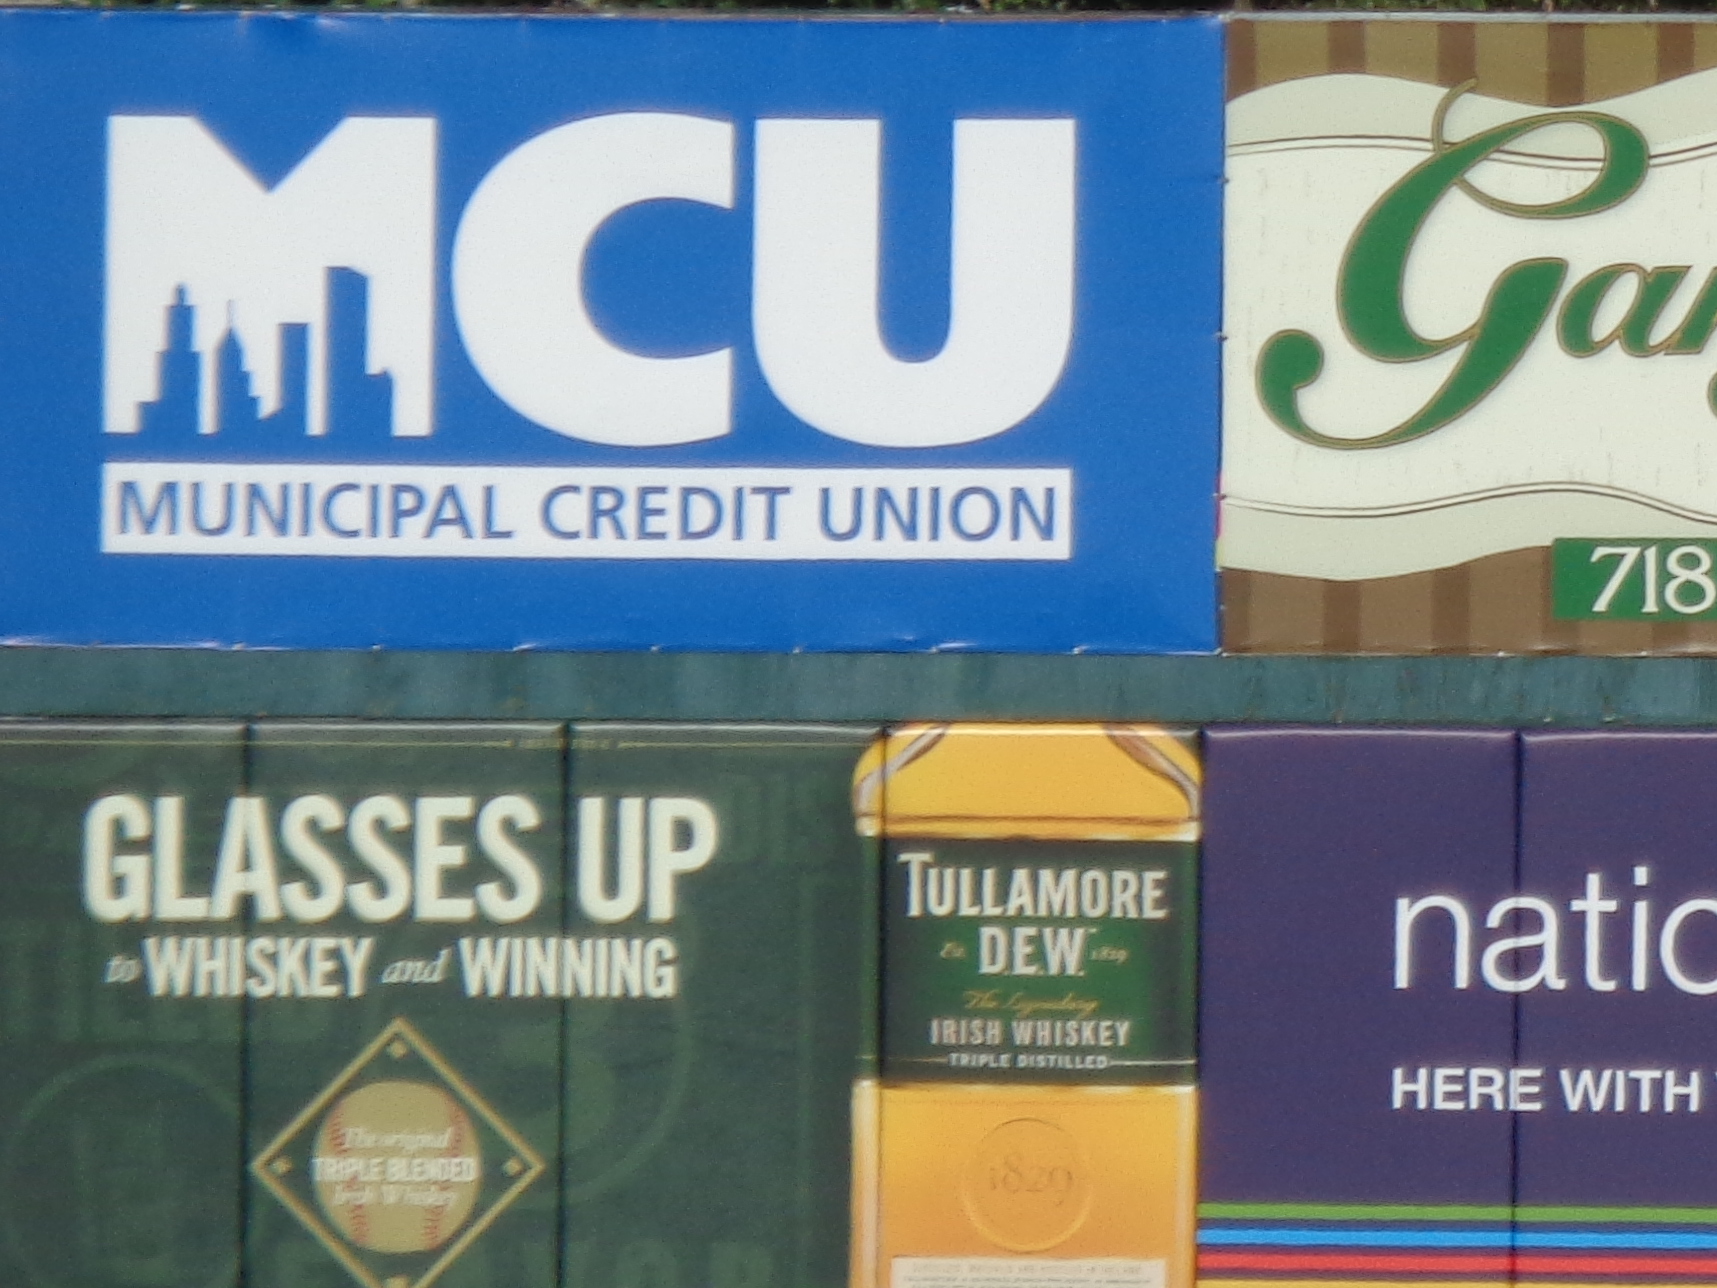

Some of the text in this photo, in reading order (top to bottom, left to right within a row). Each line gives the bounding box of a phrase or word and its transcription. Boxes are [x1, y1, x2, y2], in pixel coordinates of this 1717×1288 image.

[102, 110, 1076, 449] MCU
[116, 480, 1058, 545] MUNICIPAL CREDIT UNION
[1590, 544, 1717, 615] 718
[82, 793, 544, 925] GLASSES
[577, 795, 719, 925] UP
[897, 850, 1169, 920] TULLAMORE
[142, 936, 376, 999] WHISKEY
[380, 948, 450, 985] and
[457, 936, 678, 1000] WINNING
[930, 1017, 1131, 1047] IRISH WHISKEY
[949, 1053, 1012, 1069] TRIPLE
[1390, 1066, 1544, 1114] HERE
[1560, 1067, 1701, 1115] WITH
